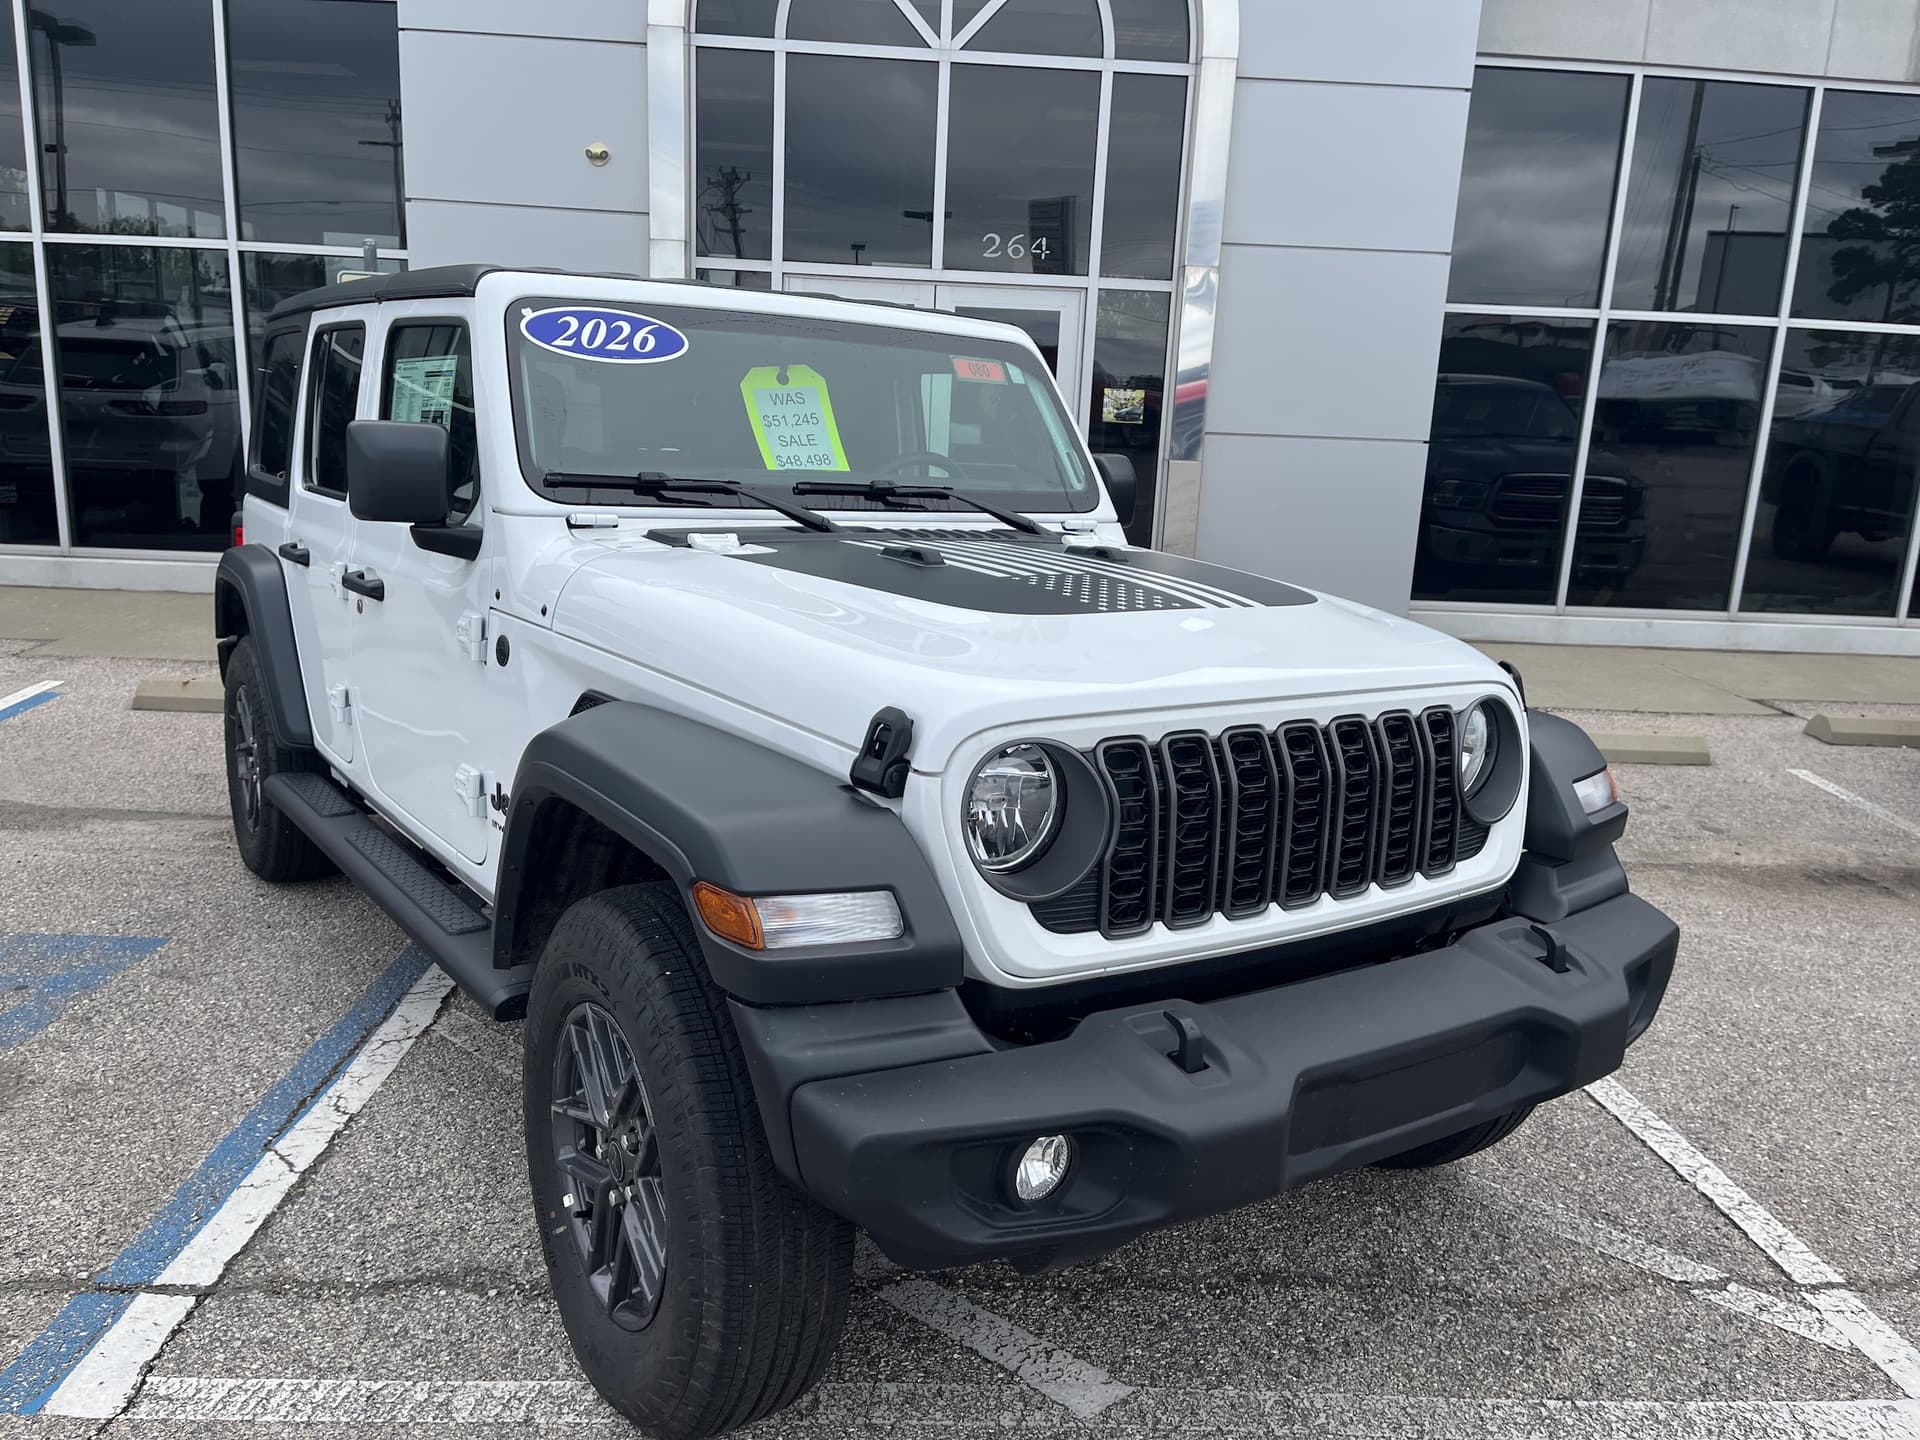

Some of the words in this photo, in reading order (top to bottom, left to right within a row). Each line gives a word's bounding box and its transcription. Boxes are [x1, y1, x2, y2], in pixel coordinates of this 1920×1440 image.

[982, 233, 1051, 260] 264
[550, 315, 660, 353] 2026
[769, 391, 806, 406] WAS
[762, 412, 819, 428] $51,245
[777, 433, 818, 447] SALE
[775, 453, 832, 468] $48,498
[490, 781, 511, 817] Je
